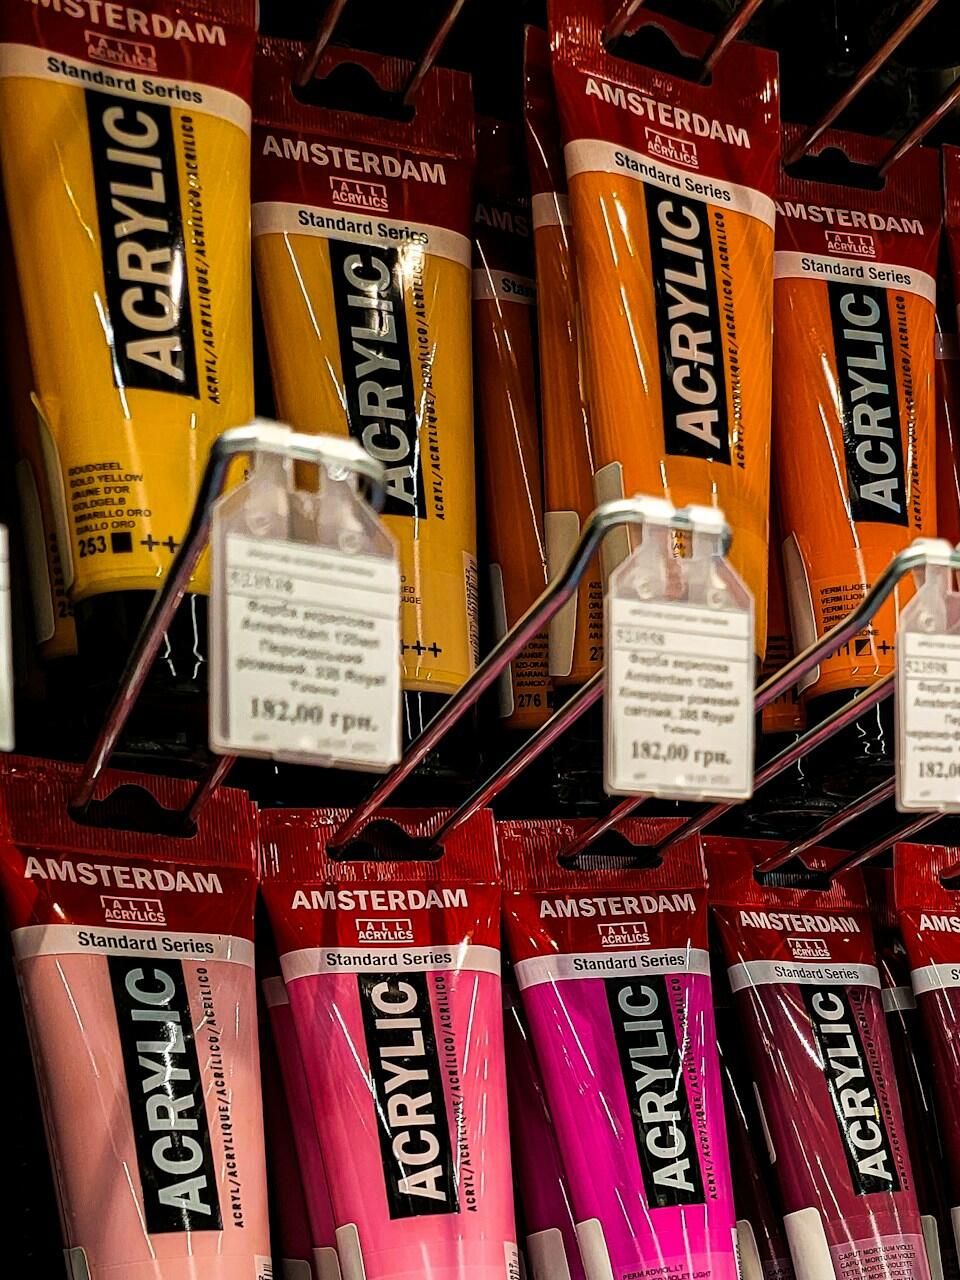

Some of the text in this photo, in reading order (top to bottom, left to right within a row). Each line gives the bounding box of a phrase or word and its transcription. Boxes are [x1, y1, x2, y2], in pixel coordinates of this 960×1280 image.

[47, 56, 202, 104] Standard Series
[585, 77, 750, 149] AMSTERDAM
[262, 135, 446, 186] AMSTERDAM
[614, 151, 730, 202] Standard Series
[102, 105, 186, 383] ACRYLIC
[801, 257, 911, 286] Standard Series
[657, 200, 721, 449] ACRYLIC
[839, 292, 902, 516] ACRYLIC
[79, 535, 106, 558] 253
[24, 857, 223, 895] AMSTERDAM
[105, 908, 166, 923] ACRYLICS
[291, 889, 468, 912] AMSTERDAM
[539, 894, 696, 919] AMSTERDAM
[741, 911, 860, 933] AMSTERDAM
[78, 931, 214, 955] Standard Series
[358, 929, 413, 941] ACRYLICS
[326, 951, 452, 968] Standard Series
[573, 952, 685, 972] Standard Series
[124, 967, 212, 1216] ACRYLIC
[370, 980, 446, 1202] ACRYLIC
[619, 984, 695, 1193] ACRYLIC
[811, 991, 893, 1181] ACRYLIC
